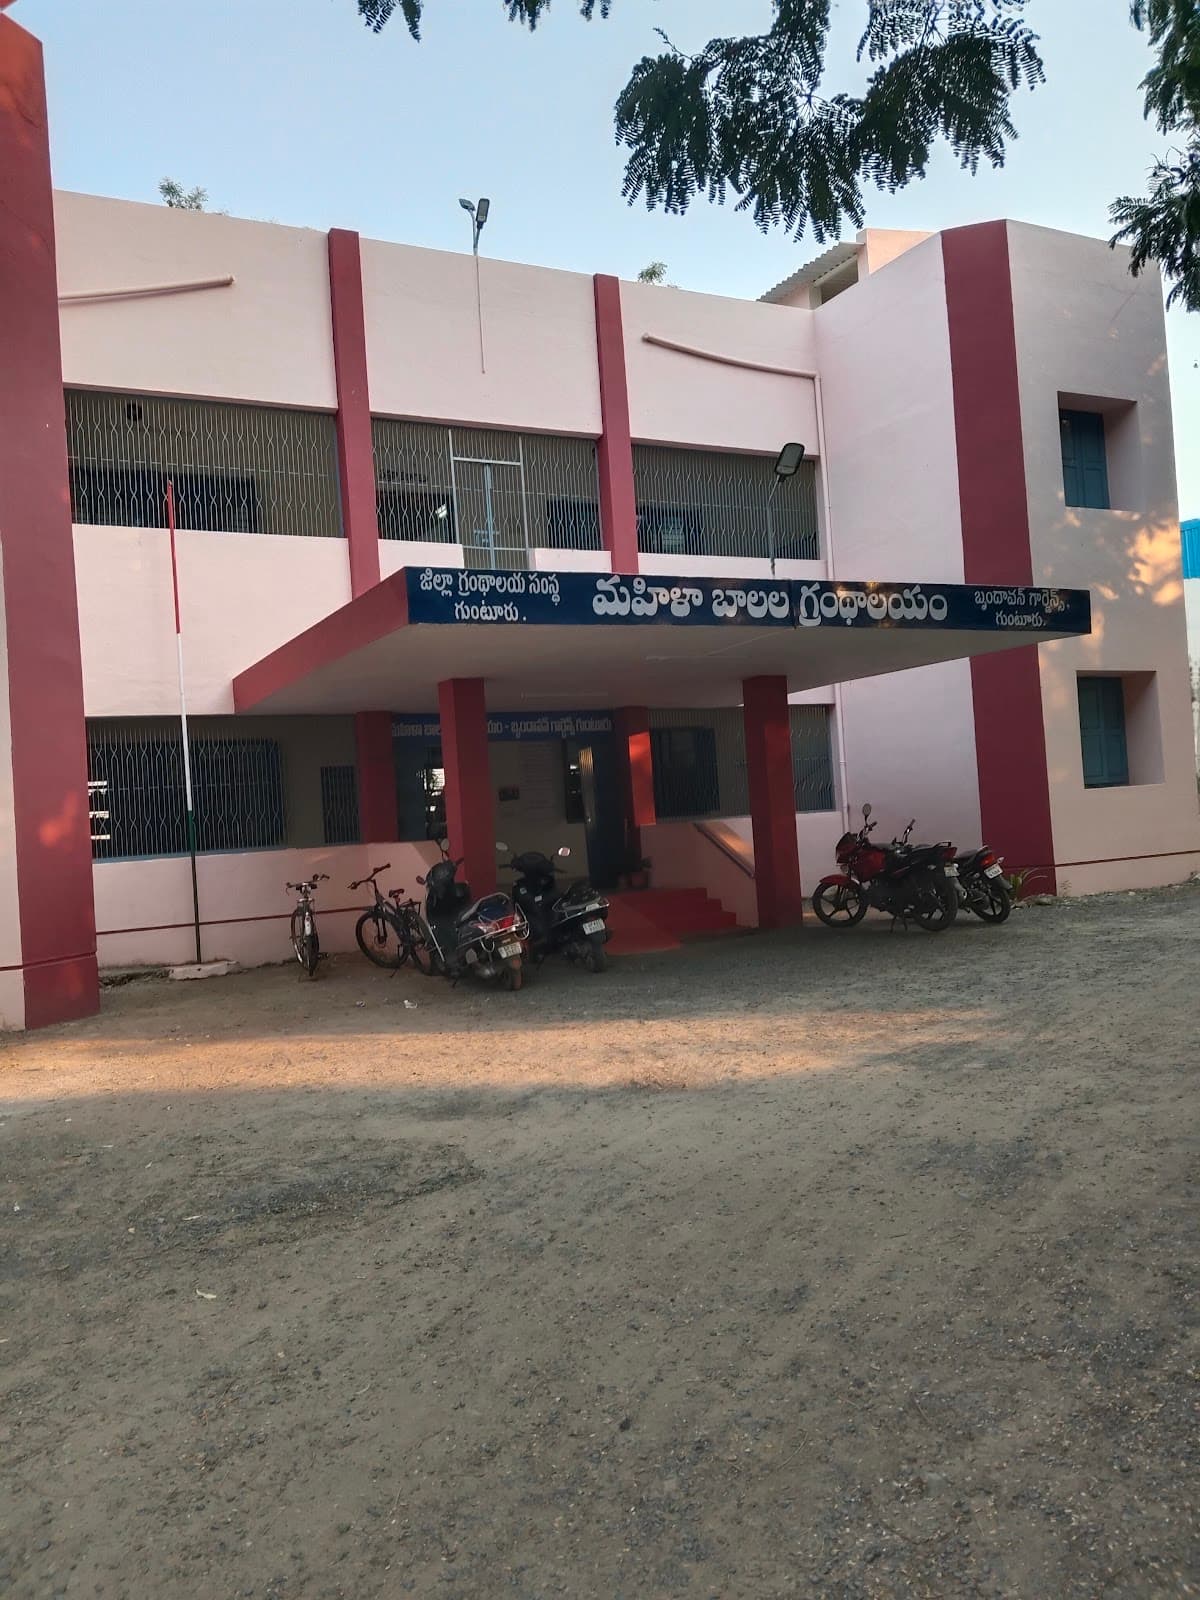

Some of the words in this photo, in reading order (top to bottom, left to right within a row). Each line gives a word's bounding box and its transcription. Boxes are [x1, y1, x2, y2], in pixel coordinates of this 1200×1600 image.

[420, 568, 453, 597] జిల్లా
[592, 574, 704, 617] మహిళా
[712, 588, 790, 619] బాలల
[974, 587, 1026, 611] బృందావన్
